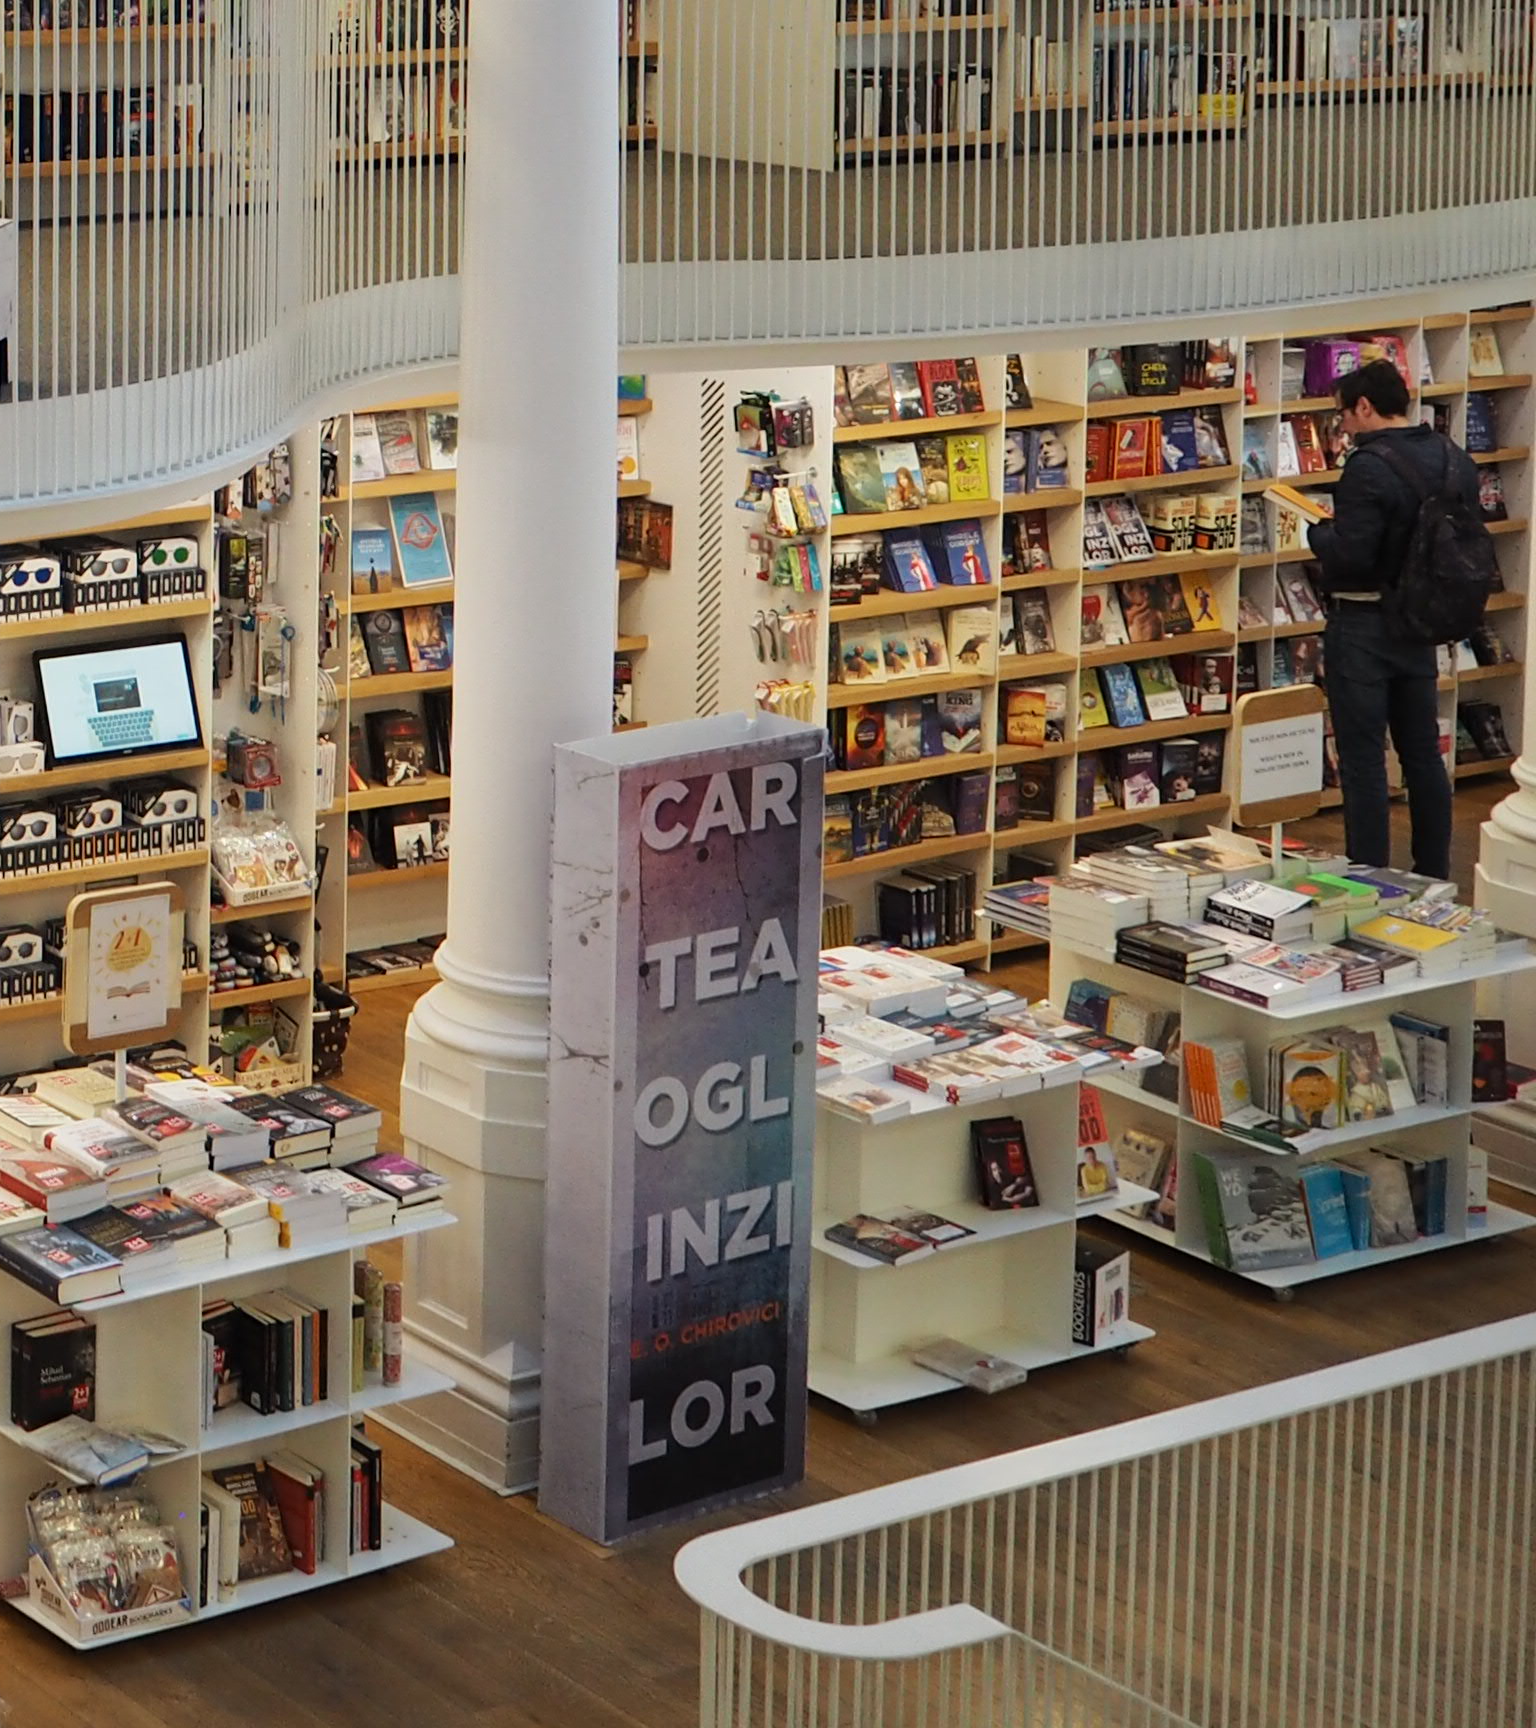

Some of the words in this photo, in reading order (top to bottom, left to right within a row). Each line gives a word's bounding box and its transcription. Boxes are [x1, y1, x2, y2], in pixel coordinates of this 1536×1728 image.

[640, 761, 798, 852] CAR
[645, 918, 797, 1009] TEA
[634, 1056, 790, 1147] OGL
[646, 1180, 793, 1283] INZI
[681, 1302, 780, 1346] CHIROVICI
[1072, 1271, 1086, 1341] BOOKENDS
[628, 1369, 776, 1465] LOR
